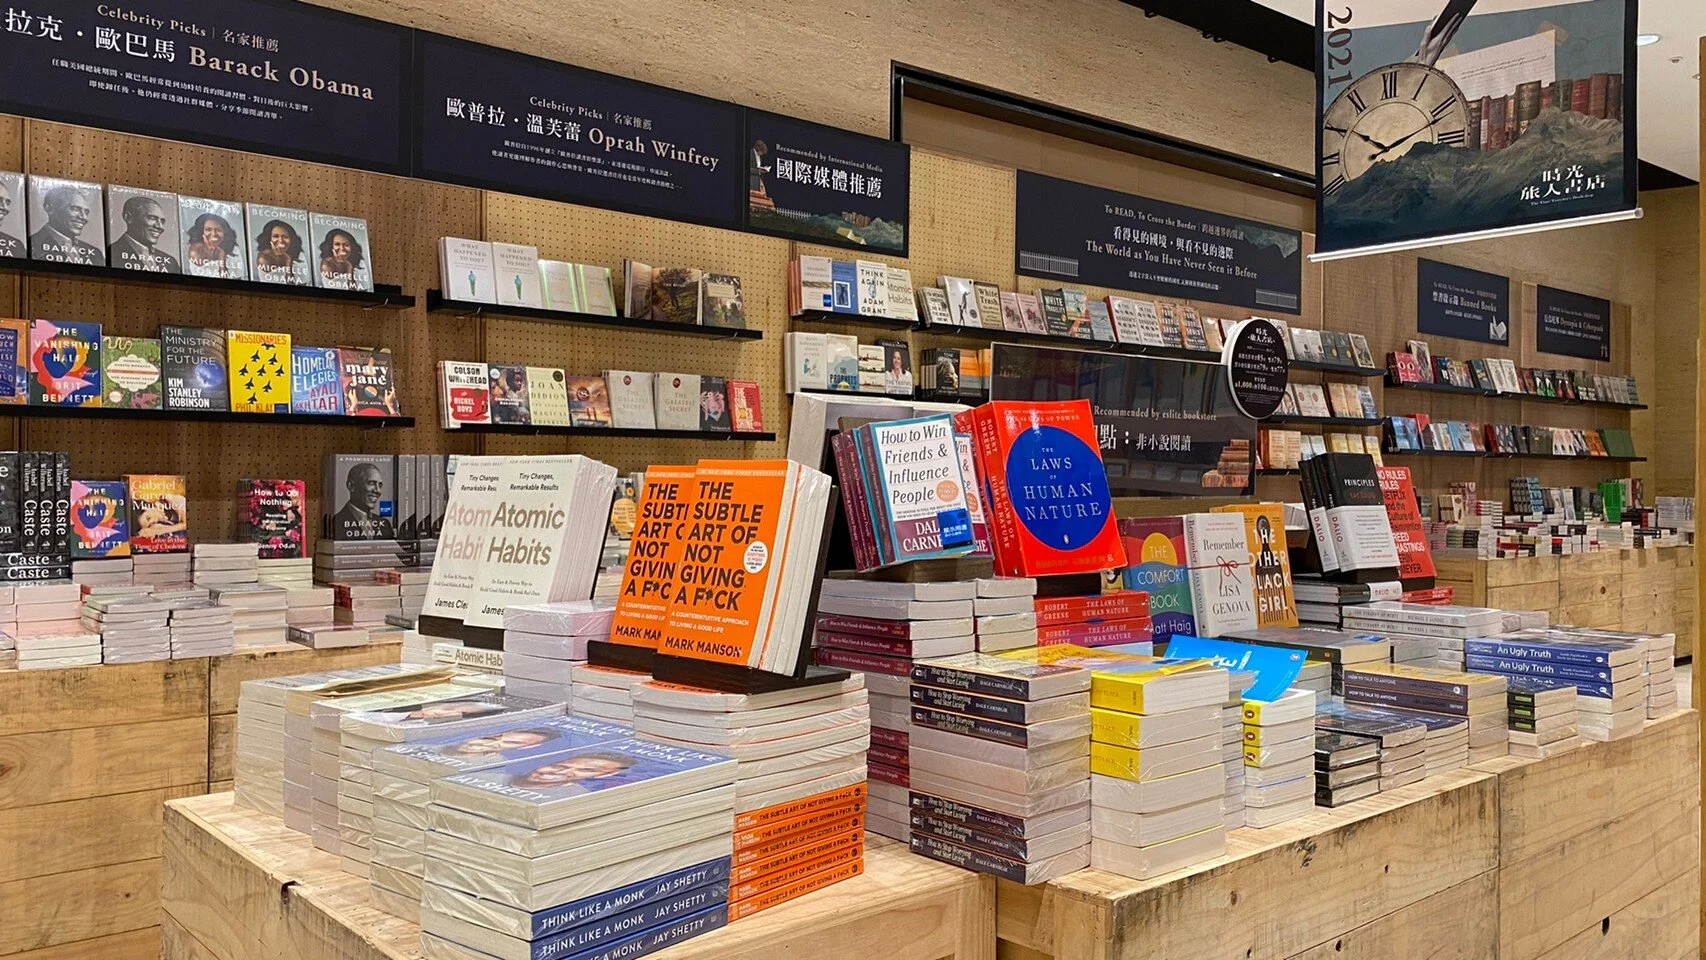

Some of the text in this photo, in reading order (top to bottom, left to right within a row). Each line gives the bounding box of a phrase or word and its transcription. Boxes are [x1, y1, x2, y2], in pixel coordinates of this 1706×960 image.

[97, 3, 206, 37] Celebrity Picks
[222, 29, 279, 53] 名家推薦
[1327, 6, 1353, 88] 2021
[189, 45, 279, 83] Barack
[289, 67, 374, 101] Obama
[530, 96, 603, 120] Celebrity Picks
[613, 112, 652, 131] 名家推薦
[588, 128, 645, 154] Oprah
[651, 139, 719, 172] Winfrey
[776, 143, 883, 173] Recommended by International Media
[776, 158, 882, 199] 國際媒體推薦
[252, 209, 306, 222] BECOMING
[1104, 204, 1197, 231] To READ, To Cross the Border
[314, 217, 365, 230] BECOMING
[43, 243, 95, 257] BARACK
[461, 242, 479, 250] WHAT
[121, 252, 171, 265] BARACK
[453, 248, 487, 258] HAPPENED
[46, 254, 94, 266] OBAMA
[470, 256, 485, 264] YOU?
[1085, 240, 1258, 280] The World as You Have Never Seen it Before
[125, 262, 169, 273] OBAMA
[258, 263, 308, 276] MICHELLE
[860, 269, 884, 277] THINK
[265, 273, 303, 285] OBAMA
[861, 279, 885, 287] AGAIN
[978, 288, 998, 297] White
[863, 298, 884, 306] ADAM
[980, 295, 999, 305] Trash
[861, 306, 887, 315] GRANT
[57, 327, 77, 336] THE
[165, 327, 183, 336] THE
[34, 340, 98, 350] VANISHING
[165, 336, 218, 347] MINISTRY
[235, 333, 287, 345] MISSIONARIES
[166, 346, 205, 355] FOR THE
[53, 353, 81, 363] HALF
[167, 354, 216, 366] FUTURE
[346, 363, 388, 377] mary
[55, 381, 81, 391] BRIT
[168, 377, 183, 388] KIM
[293, 371, 337, 393] ELEGIES
[350, 374, 387, 387] jane
[530, 381, 565, 390] JOAN
[168, 388, 202, 398] STANLEY
[310, 381, 338, 397] AYAD
[42, 393, 95, 404] BENNETT
[169, 397, 210, 408] ROBINSON
[531, 392, 566, 400] DIDION
[1094, 405, 1217, 421] Recommended by eslite bookstore
[881, 424, 946, 444] How to Win
[980, 420, 991, 456] GREENE
[987, 418, 998, 453] ROBERT
[885, 443, 948, 464] Friends &
[1031, 457, 1072, 471] LAWS
[519, 472, 554, 481] Tiny Changes,
[889, 466, 949, 484] Influence
[1386, 470, 1407, 480] RULES
[132, 480, 176, 491] Gabriel
[510, 483, 541, 492] Remarkable
[1344, 478, 1375, 487] PRINCIPLES
[254, 488, 272, 498] How
[699, 481, 734, 500] THE
[892, 486, 934, 505] People
[1023, 483, 1093, 500] HUMAN
[259, 498, 293, 508] Nothing
[491, 501, 566, 530] Atomic
[693, 502, 763, 523] SUBTLE
[1025, 502, 1102, 520] NATURE
[24, 500, 37, 536] Caste
[344, 520, 386, 529] BARACK
[346, 529, 383, 538] OBAMA
[688, 523, 758, 545] ART OF
[1253, 528, 1276, 544] THE
[1332, 516, 1343, 543] DALIO
[486, 536, 552, 565] Habits
[1149, 545, 1168, 558] THE
[1203, 539, 1245, 551] Remember
[1396, 542, 1425, 552] HASTINGS
[7, 554, 50, 567] Caste
[684, 544, 724, 564] NOT
[1401, 563, 1422, 574] MEYER
[680, 565, 745, 589] GIVING
[1137, 569, 1185, 585] COMFORT
[674, 586, 688, 606] A
[1219, 586, 1241, 597] LISA
[1150, 594, 1180, 609] BOOK
[1258, 595, 1289, 612] GIRL
[481, 605, 505, 616] James
[1212, 603, 1251, 616] GENOVA
[676, 611, 749, 626] COUNTERINTUITIVE APPROACH
[665, 637, 742, 658] MARK MANSON
[1497, 646, 1508, 655] An
[1509, 646, 1528, 660] Ugly
[1529, 647, 1551, 658] Truth
[760, 796, 835, 820] THE SUBTLE ART OF NOT GIVING
[542, 870, 708, 929] THINK LIKE A MONK JAY SHETTY
